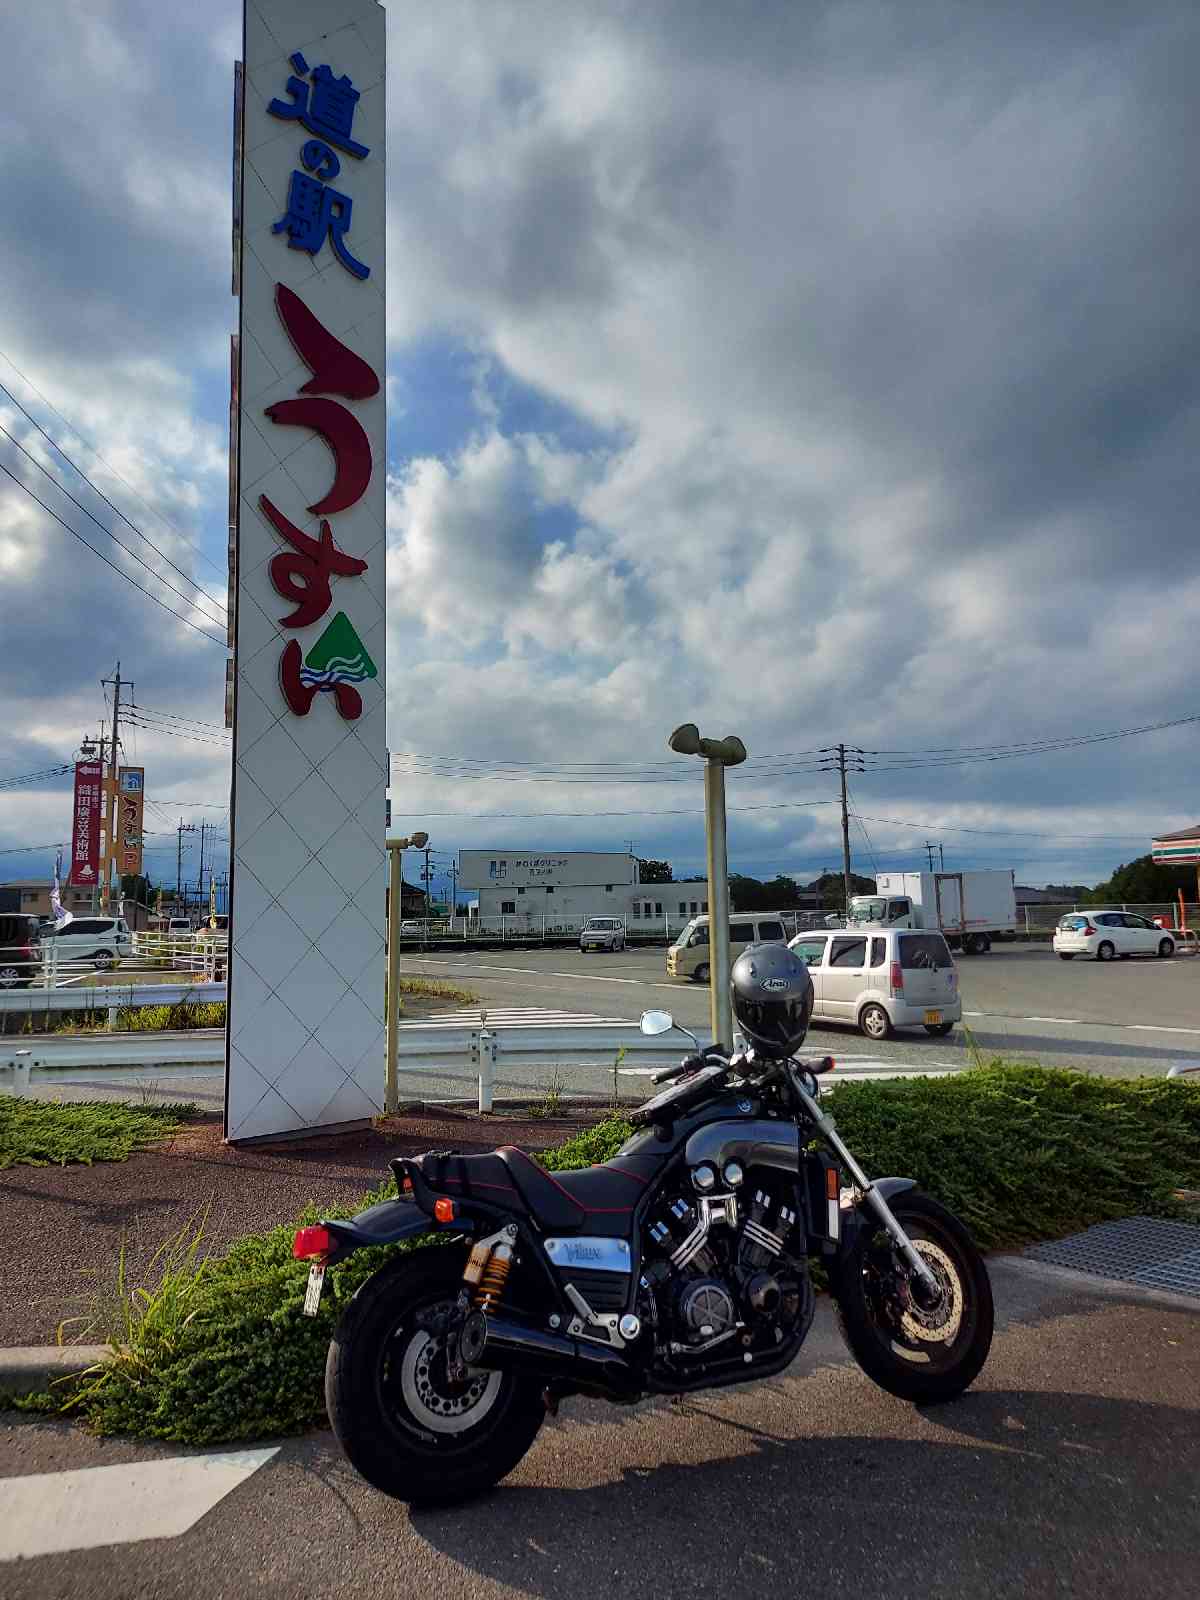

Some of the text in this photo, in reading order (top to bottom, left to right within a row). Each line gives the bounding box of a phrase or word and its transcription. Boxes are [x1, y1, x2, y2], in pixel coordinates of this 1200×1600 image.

[266, 51, 370, 280] 道の駅
[123, 852, 138, 869] P
